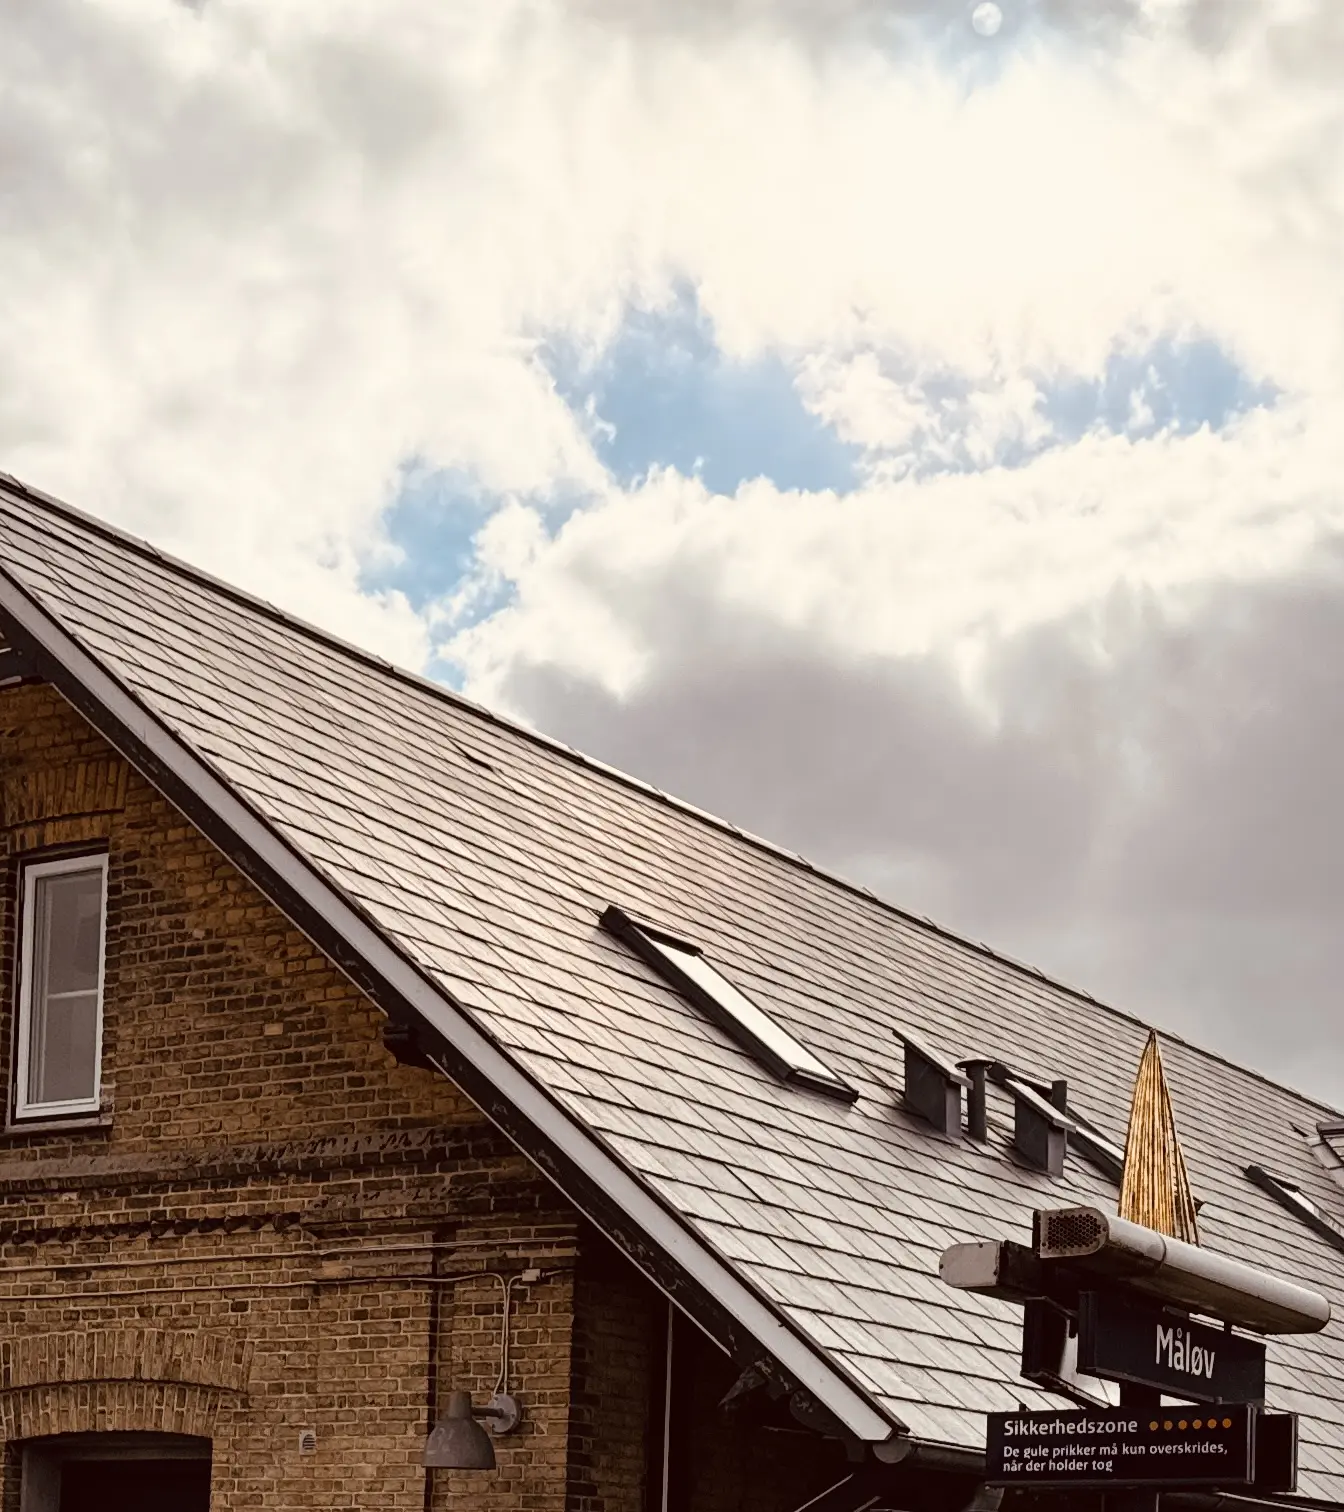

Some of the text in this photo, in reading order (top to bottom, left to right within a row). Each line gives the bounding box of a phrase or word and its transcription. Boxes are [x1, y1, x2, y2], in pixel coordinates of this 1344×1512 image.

[1156, 1323, 1216, 1379] Måløv
[1004, 1418, 1138, 1436] Sikkerhedszone
[1003, 1441, 1228, 1459] De gule prikker må kun overskrides,
[1003, 1459, 1113, 1473] når der holder tog
